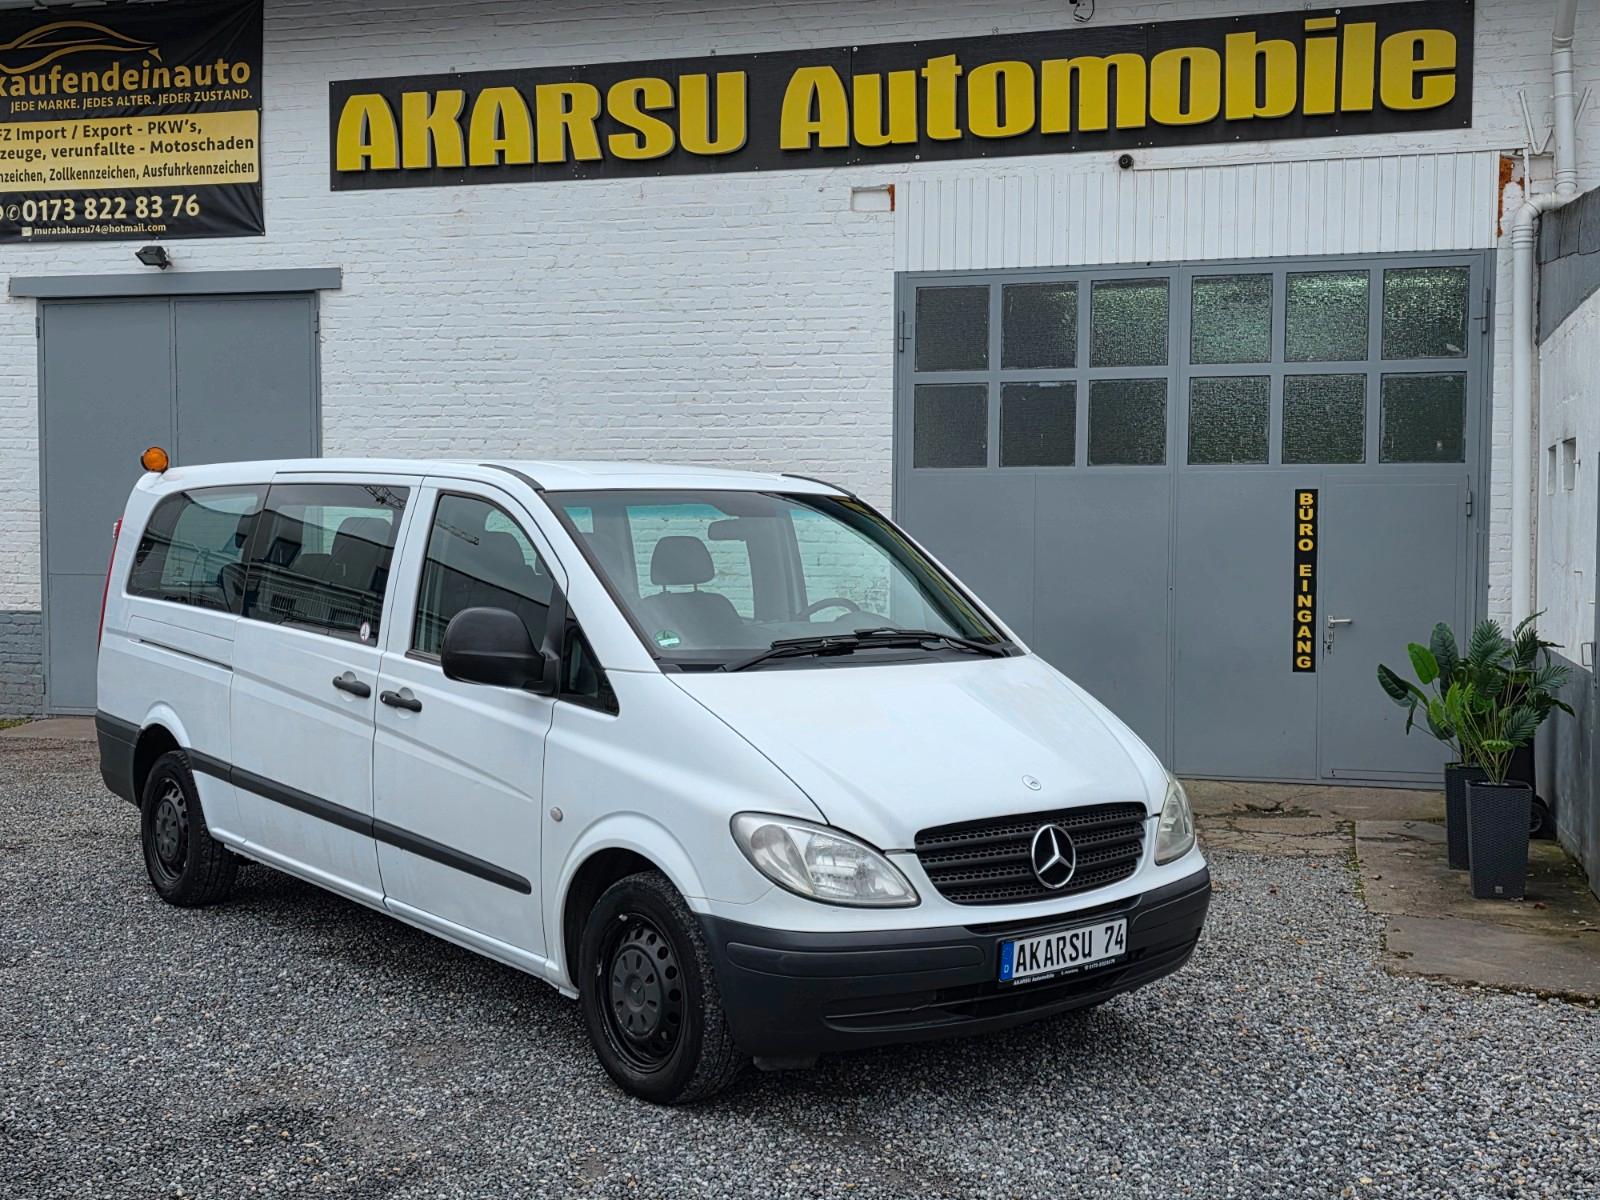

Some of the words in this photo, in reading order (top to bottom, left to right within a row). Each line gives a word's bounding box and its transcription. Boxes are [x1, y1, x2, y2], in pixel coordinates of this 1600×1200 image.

[10, 101, 35, 114] JEDE
[38, 98, 80, 110] MARKE.
[83, 96, 114, 110] JEDES
[116, 94, 156, 107] ALTER.
[158, 92, 192, 106] JEDER
[194, 88, 253, 102] ZUSTAND.
[336, 70, 748, 172] AKARSU
[779, 16, 1458, 150] Automobile
[16, 126, 67, 143] Import
[83, 121, 133, 140] Export
[147, 119, 202, 135] PKW's,
[0, 148, 46, 163] zeuge,
[51, 142, 135, 158] verunfallte
[150, 135, 254, 154] Motoschaden
[49, 165, 140, 181] Zollkennzeichen,
[142, 159, 254, 178] Ausfuhrkennzeichen
[22, 198, 76, 222] 0173
[84, 197, 127, 220] 822
[135, 195, 163, 218] 83
[171, 194, 200, 217] 76
[34, 223, 167, 236] muratakarsu74@hotmail.com
[1298, 493, 1314, 551] BÜRO
[1296, 564, 1312, 668] EINGANG
[1015, 930, 1093, 974] AKARSU
[1104, 923, 1125, 954] 74
